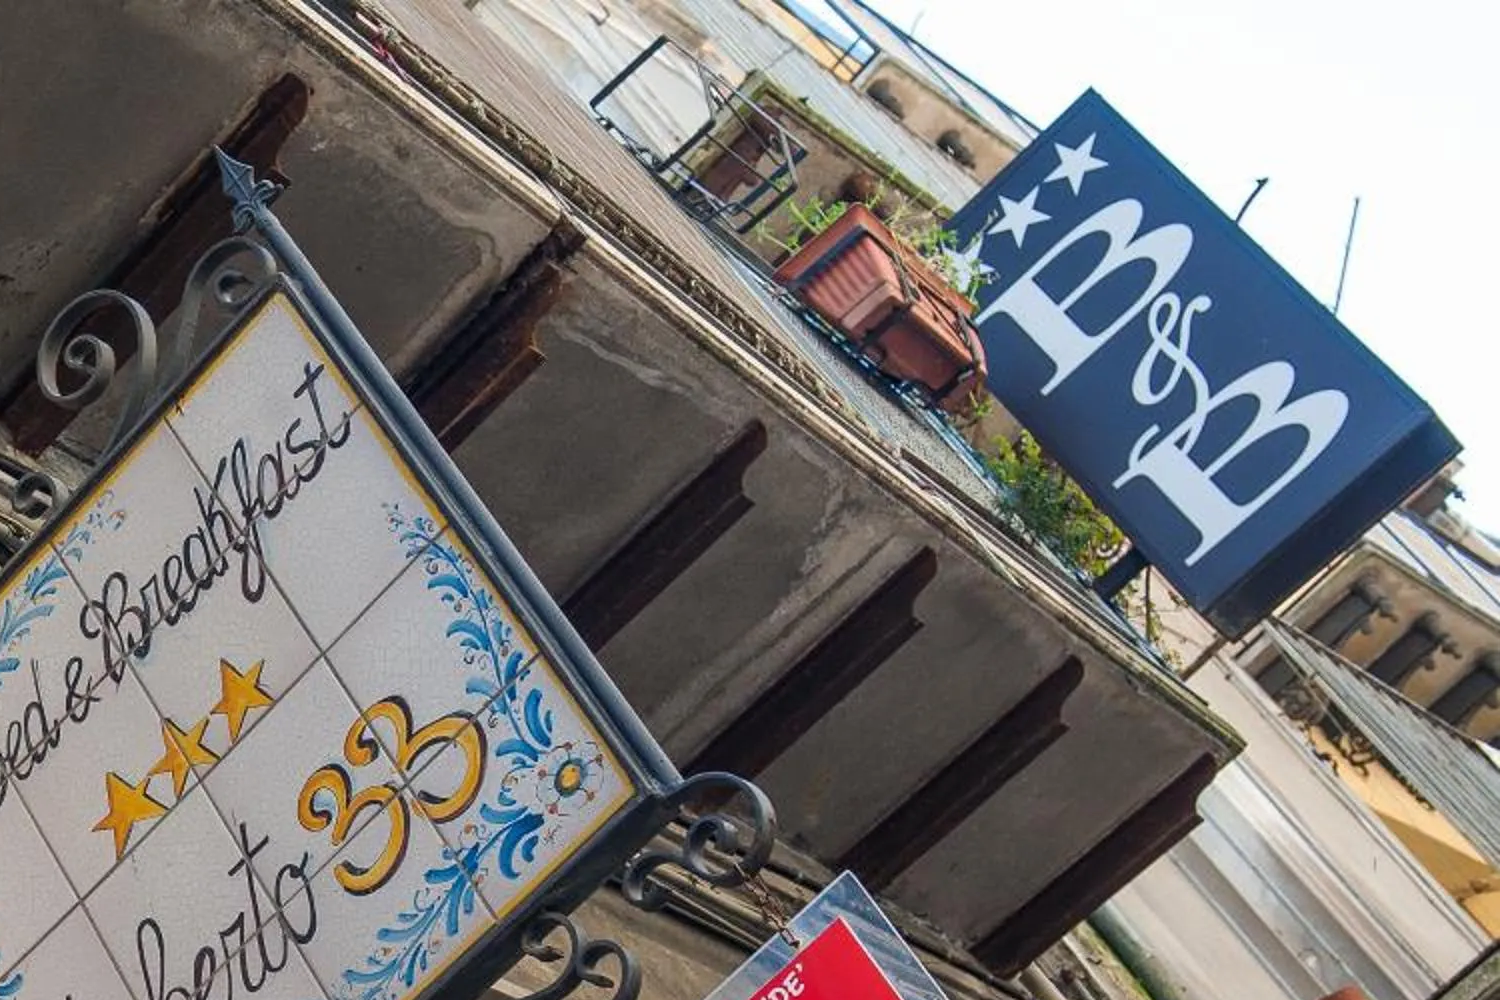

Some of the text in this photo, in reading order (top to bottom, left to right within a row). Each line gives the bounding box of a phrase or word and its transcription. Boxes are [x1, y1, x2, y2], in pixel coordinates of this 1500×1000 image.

[974, 198, 1350, 567] B&B
[80, 361, 351, 690] Breakfast
[65, 656, 101, 723] &
[298, 696, 486, 895] 33
